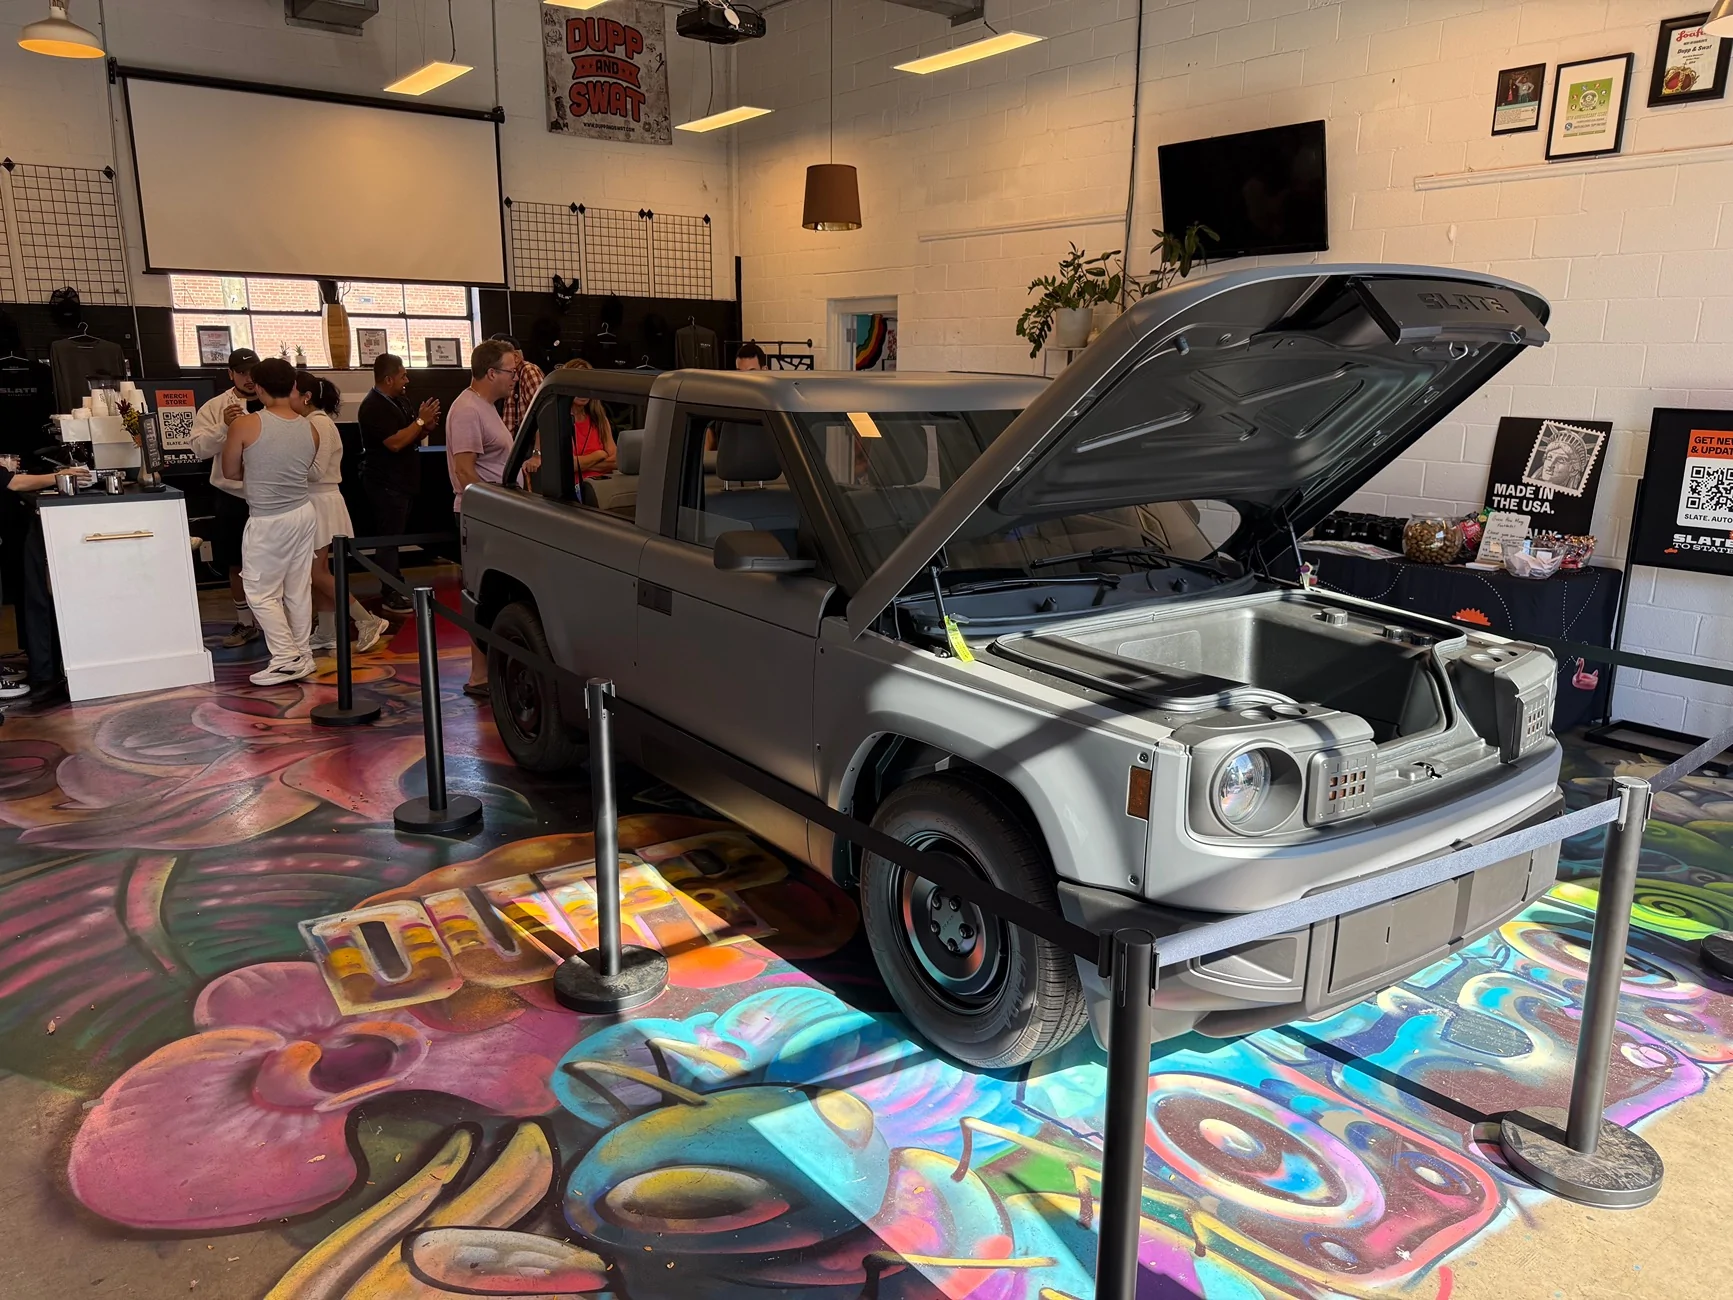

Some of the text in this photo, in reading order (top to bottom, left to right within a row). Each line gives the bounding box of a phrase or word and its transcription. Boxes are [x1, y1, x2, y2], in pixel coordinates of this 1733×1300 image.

[566, 17, 644, 60] DUPP
[595, 59, 620, 75] AND
[569, 81, 646, 123] SWAT
[1417, 292, 1510, 313] SLATE
[1694, 436, 1715, 445] GET
[1691, 445, 1699, 454] &
[1493, 483, 1555, 500] MADE IN
[1492, 496, 1555, 514] THE USA.
[1672, 542, 1691, 550] TO
[1673, 533, 1733, 548] SLATE
